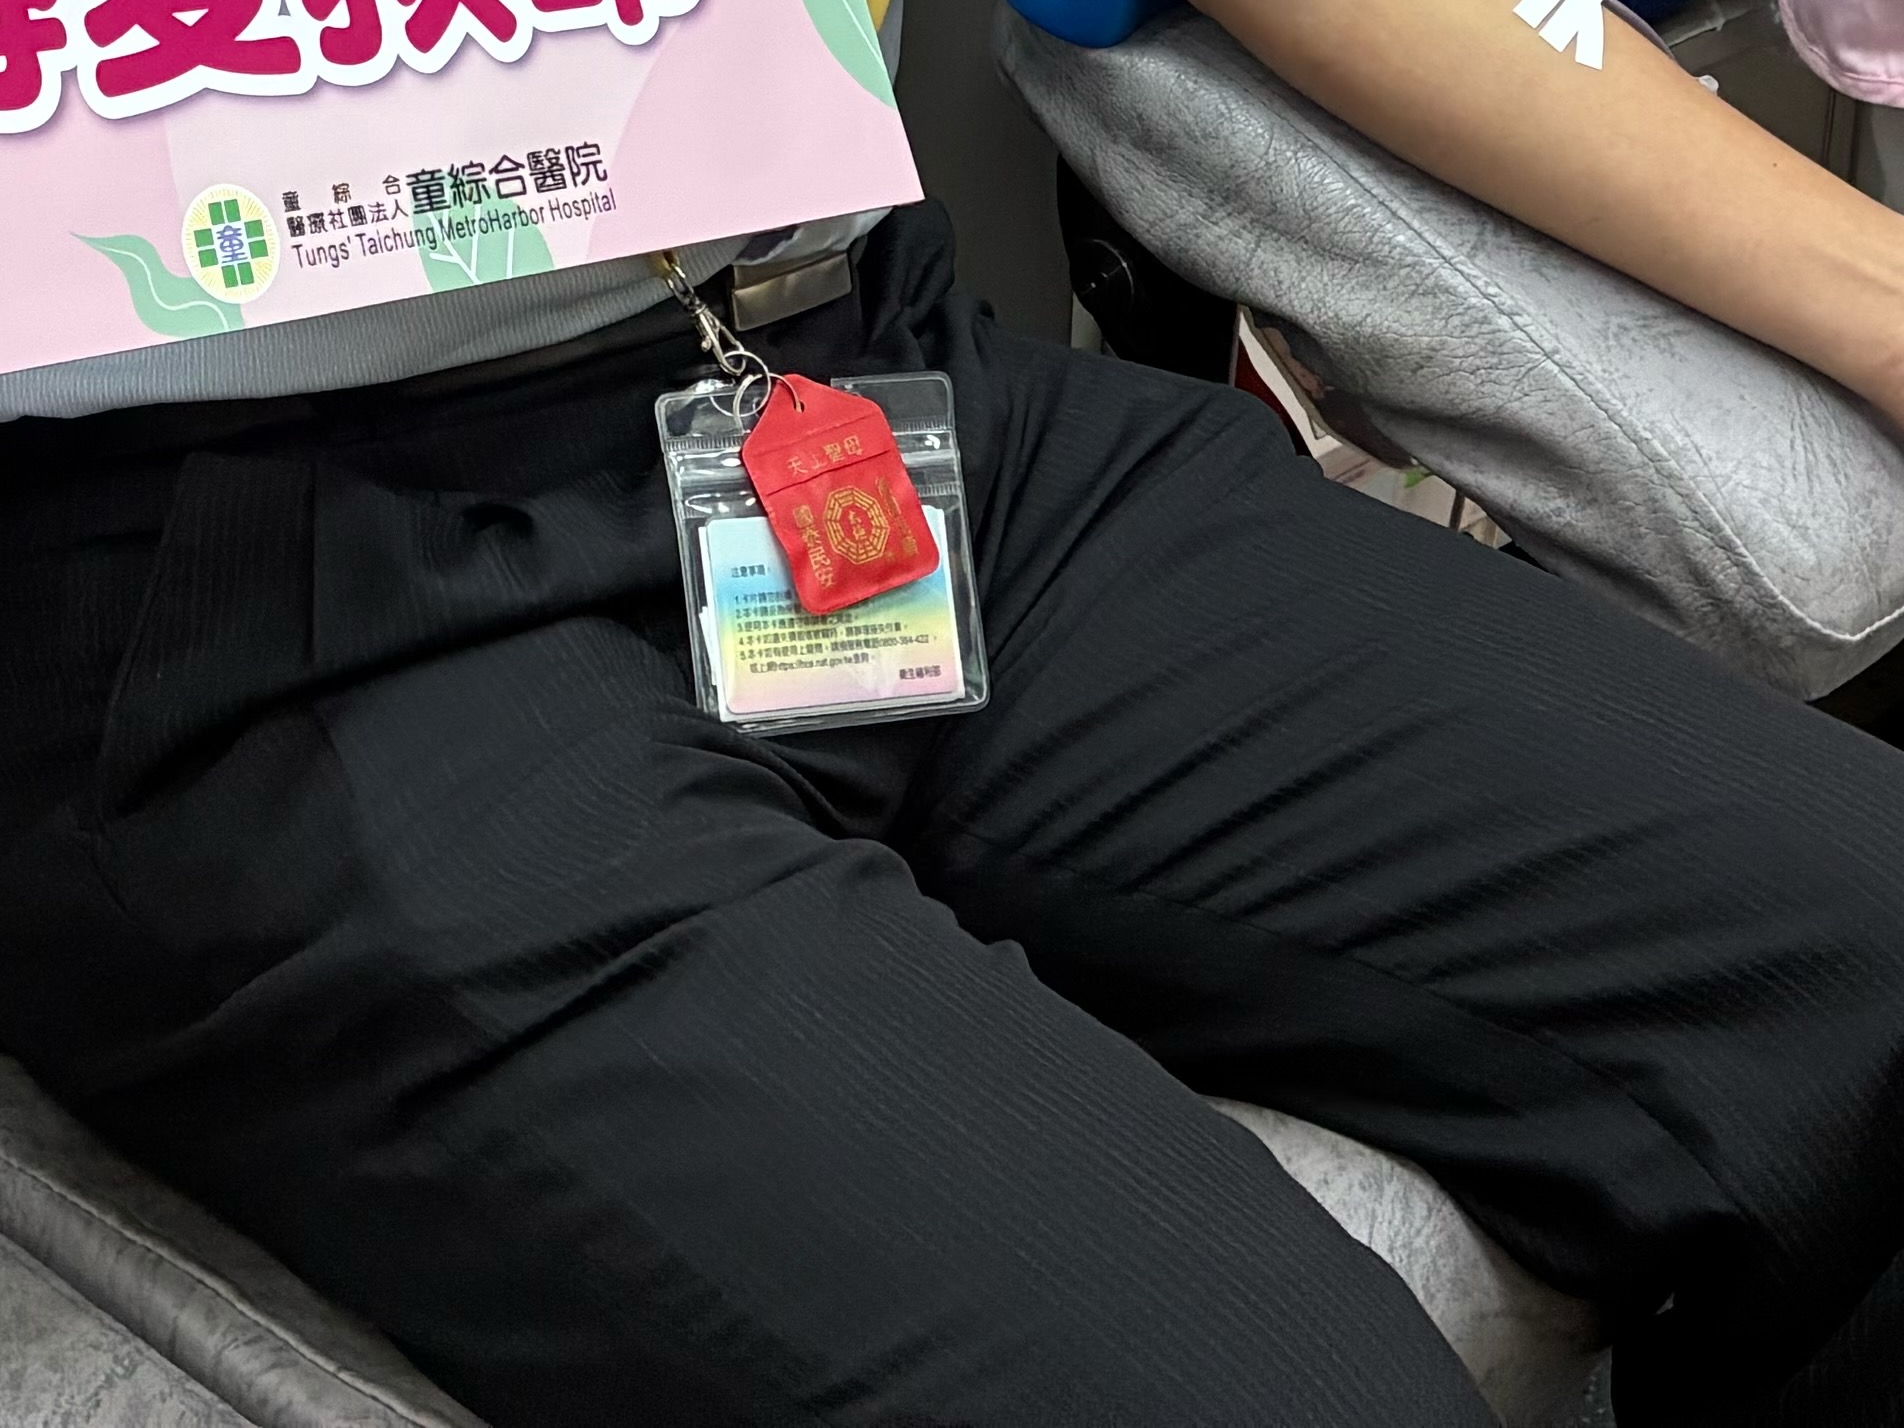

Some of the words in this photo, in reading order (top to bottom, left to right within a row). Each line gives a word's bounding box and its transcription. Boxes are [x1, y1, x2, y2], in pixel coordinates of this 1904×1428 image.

[406, 141, 609, 216] 童綜合醫院
[287, 199, 409, 238] 醫療社團法人
[291, 235, 353, 269] Tungs'
[355, 223, 437, 258] Taichung
[440, 206, 546, 242] MetroHarbor
[549, 187, 618, 228] Hospital
[216, 224, 245, 264] 童
[786, 434, 864, 477] 天上聖母
